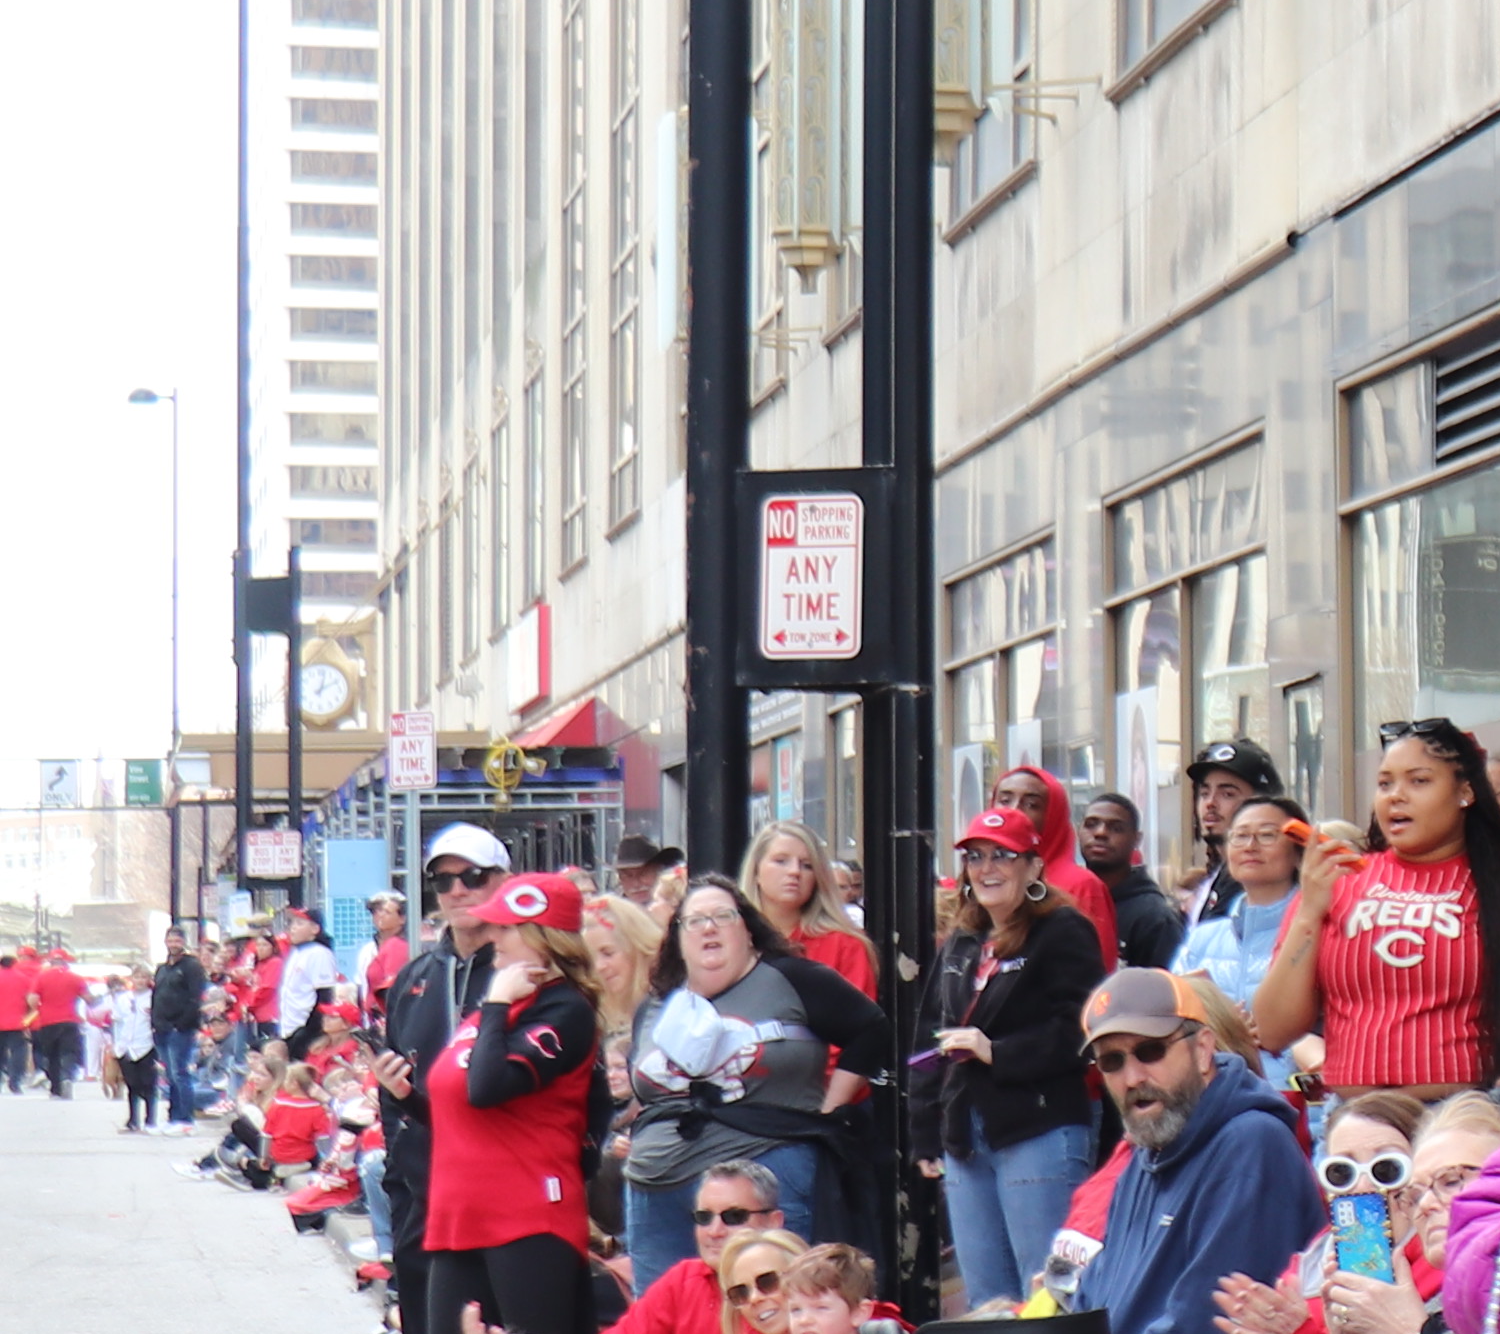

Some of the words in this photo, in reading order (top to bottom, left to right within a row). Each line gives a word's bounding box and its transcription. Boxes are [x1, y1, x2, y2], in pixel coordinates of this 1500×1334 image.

[801, 506, 853, 523] STOPPING
[768, 508, 796, 539] NO
[803, 525, 851, 541] PARKING
[785, 555, 838, 584] ANY
[782, 593, 841, 621] TIME
[789, 631, 806, 643] TOW
[808, 631, 833, 644] ZONE
[401, 739, 425, 755] ANY
[399, 757, 428, 772] TIME
[1346, 899, 1464, 940] REDS
